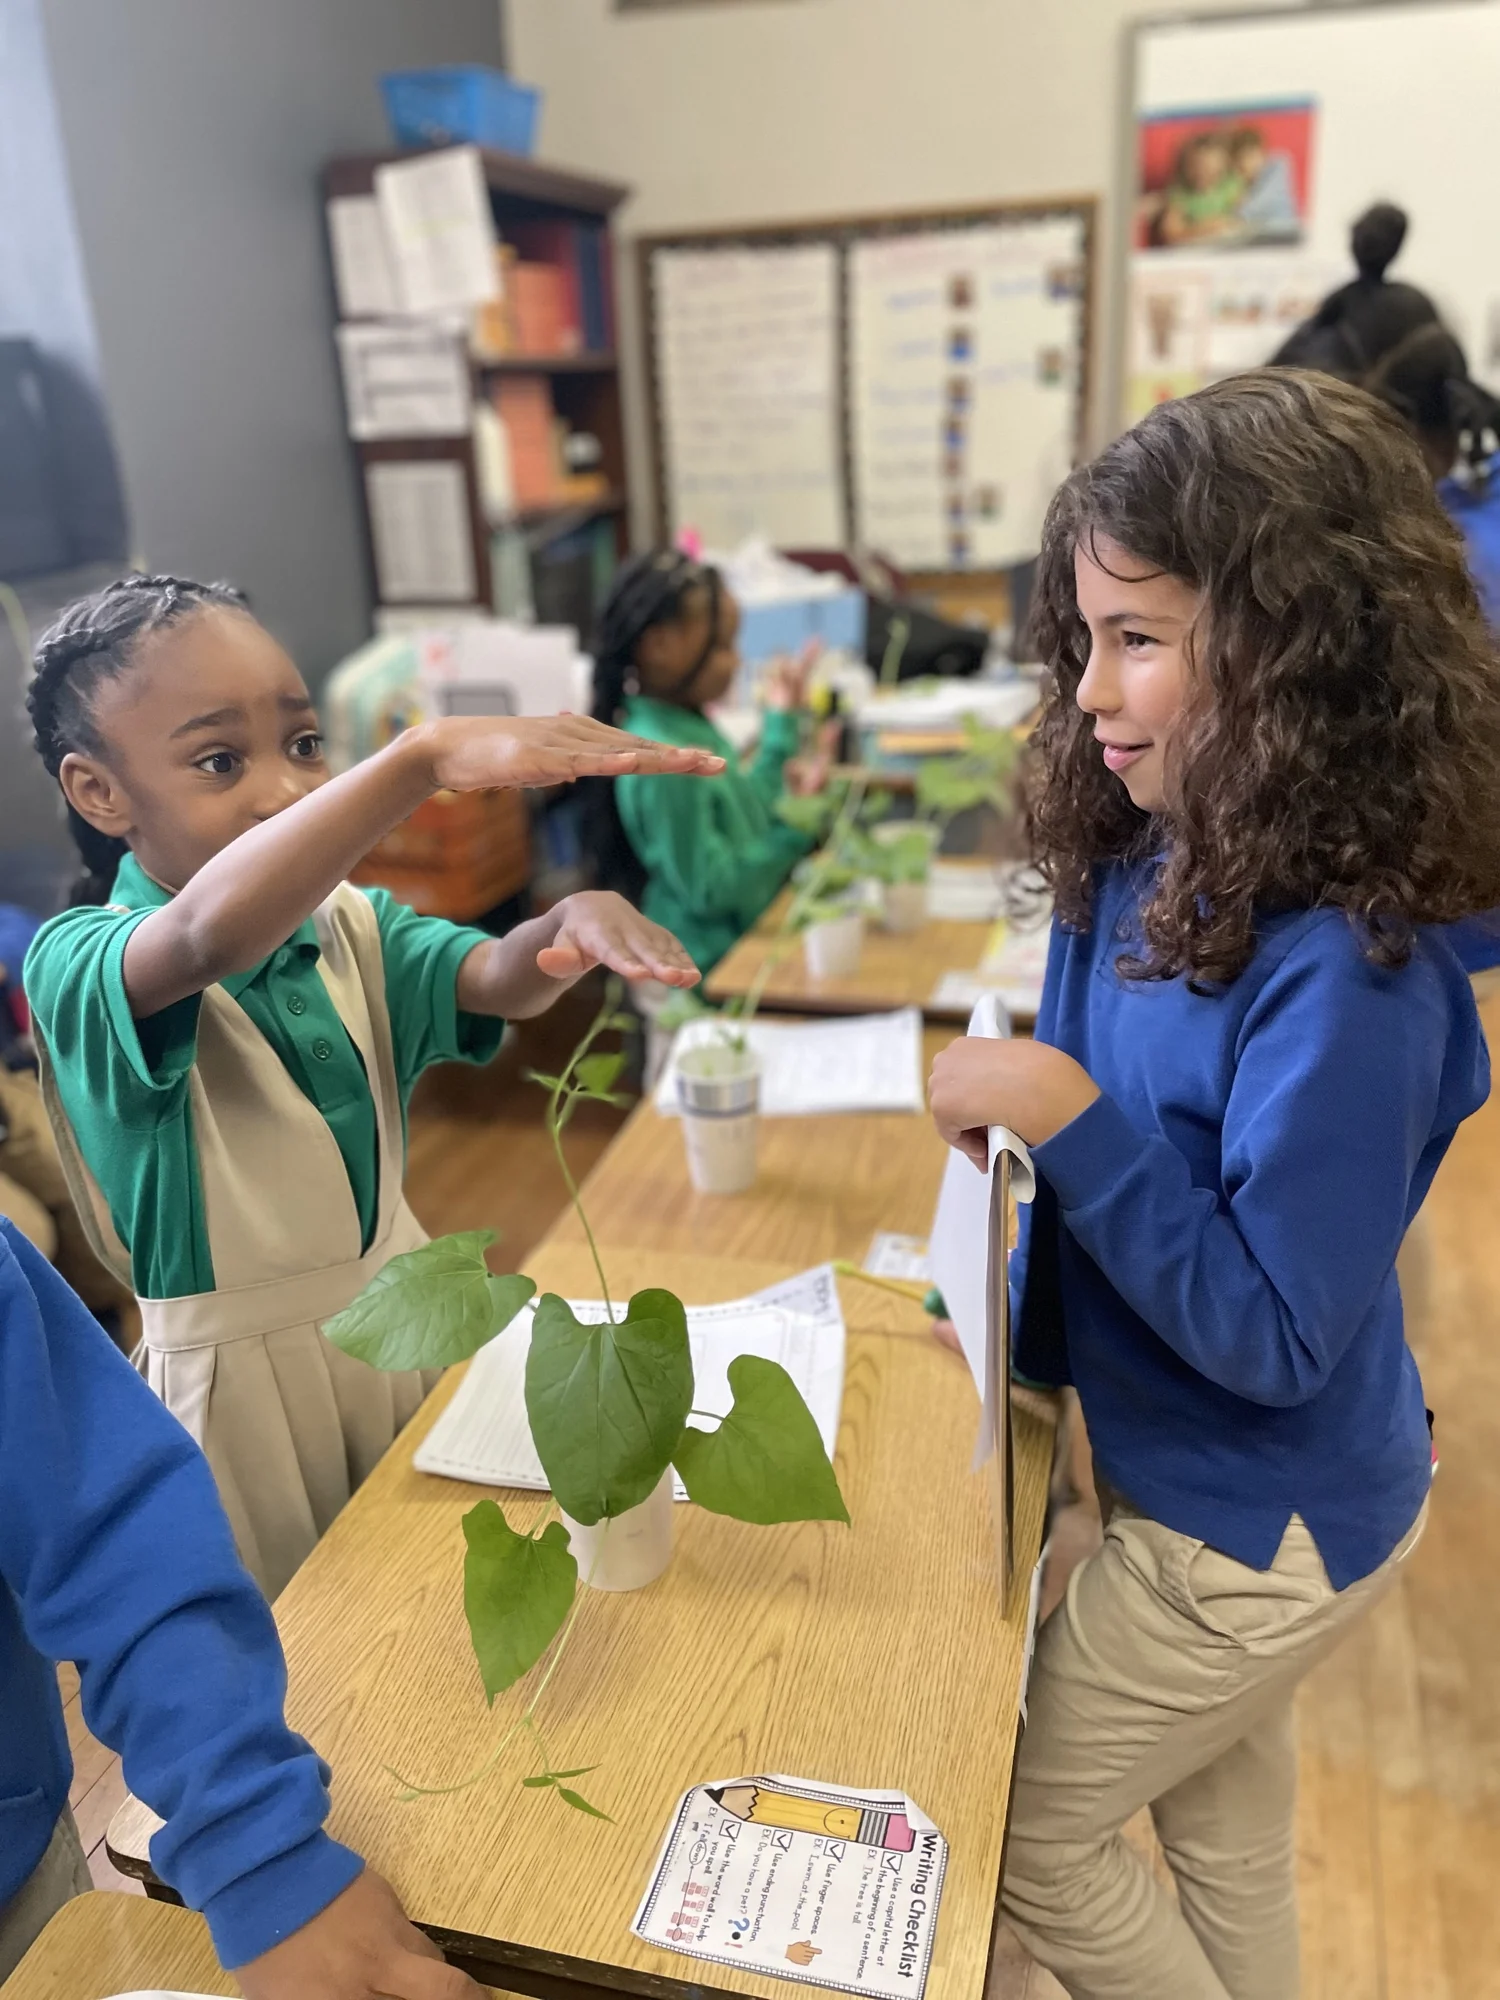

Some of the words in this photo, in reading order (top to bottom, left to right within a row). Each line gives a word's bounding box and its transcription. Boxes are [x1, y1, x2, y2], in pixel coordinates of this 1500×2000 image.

[709, 1841, 720, 1856] you
[724, 1843, 737, 1859] Use
[757, 1841, 769, 1852] Do
[719, 1860, 731, 1873] the
[771, 1852, 784, 1868] Use
[910, 1832, 938, 1895] Writing
[746, 1868, 760, 1887] have
[824, 1863, 837, 1878] Use
[861, 1866, 874, 1881] The
[877, 1869, 888, 1883] the
[711, 1874, 724, 1896] word
[761, 1868, 776, 1894] ending
[891, 1877, 903, 1892] Use
[818, 1879, 833, 1905] finger
[857, 1882, 869, 1901] tree
[866, 1884, 886, 1921] beginning
[883, 1900, 895, 1929] capital
[695, 1924, 711, 1942] help
[866, 1920, 877, 1933] of
[879, 1928, 893, 1955] letter
[897, 1899, 927, 1978] Checklist
[855, 1940, 870, 1980] sentence.
